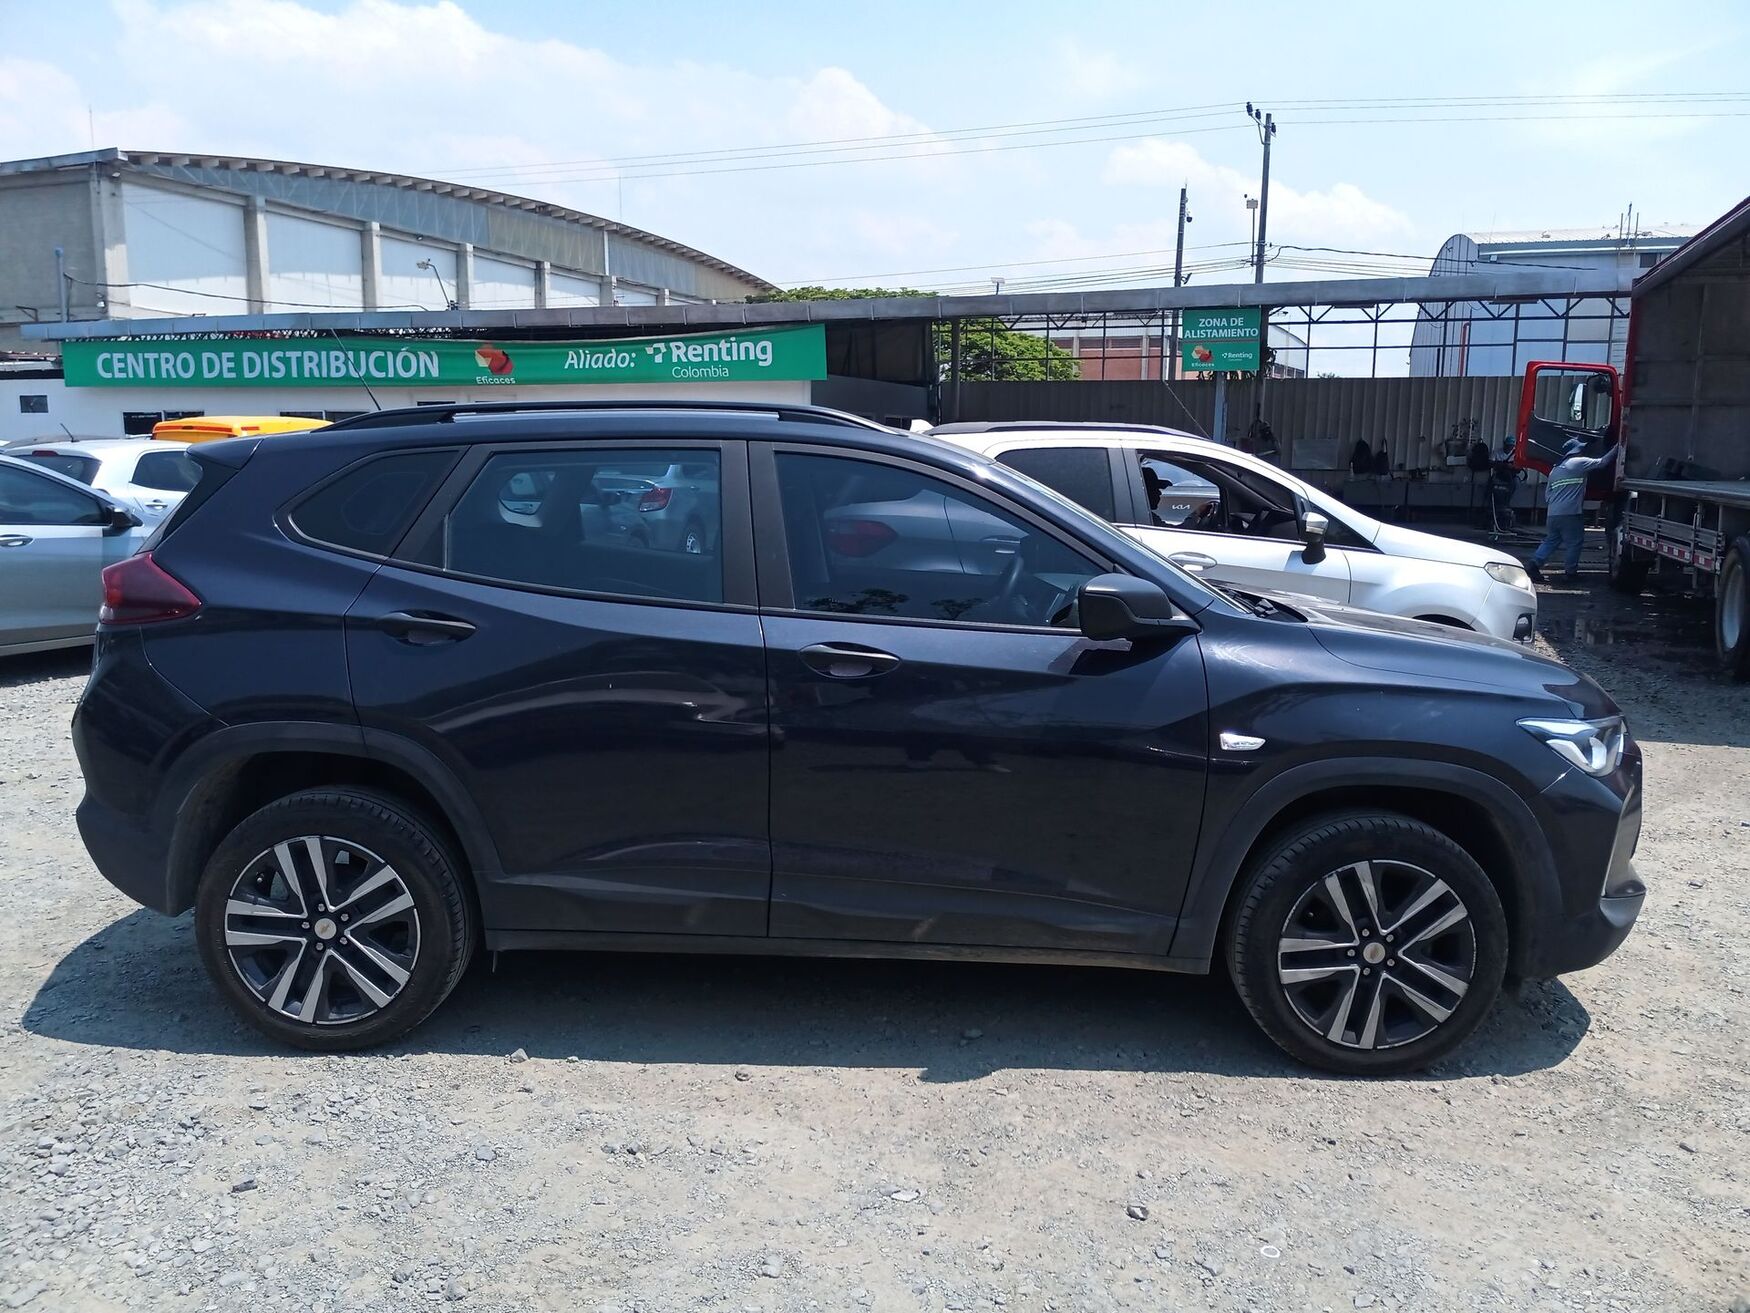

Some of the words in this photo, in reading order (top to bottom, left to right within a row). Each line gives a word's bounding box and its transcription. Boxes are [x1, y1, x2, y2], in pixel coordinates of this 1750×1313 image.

[1199, 318, 1227, 327] ZONA
[1230, 317, 1244, 327] DE
[1184, 329, 1258, 338] ALISTAMIENTO
[563, 348, 637, 370] Aliado:
[671, 337, 774, 367] Renting
[96, 352, 196, 380] CENTRO
[202, 351, 237, 379] DE
[242, 346, 440, 379] DISTRIBUCIÓN
[672, 365, 730, 379] Colombia
[475, 375, 517, 385] Eficaces
